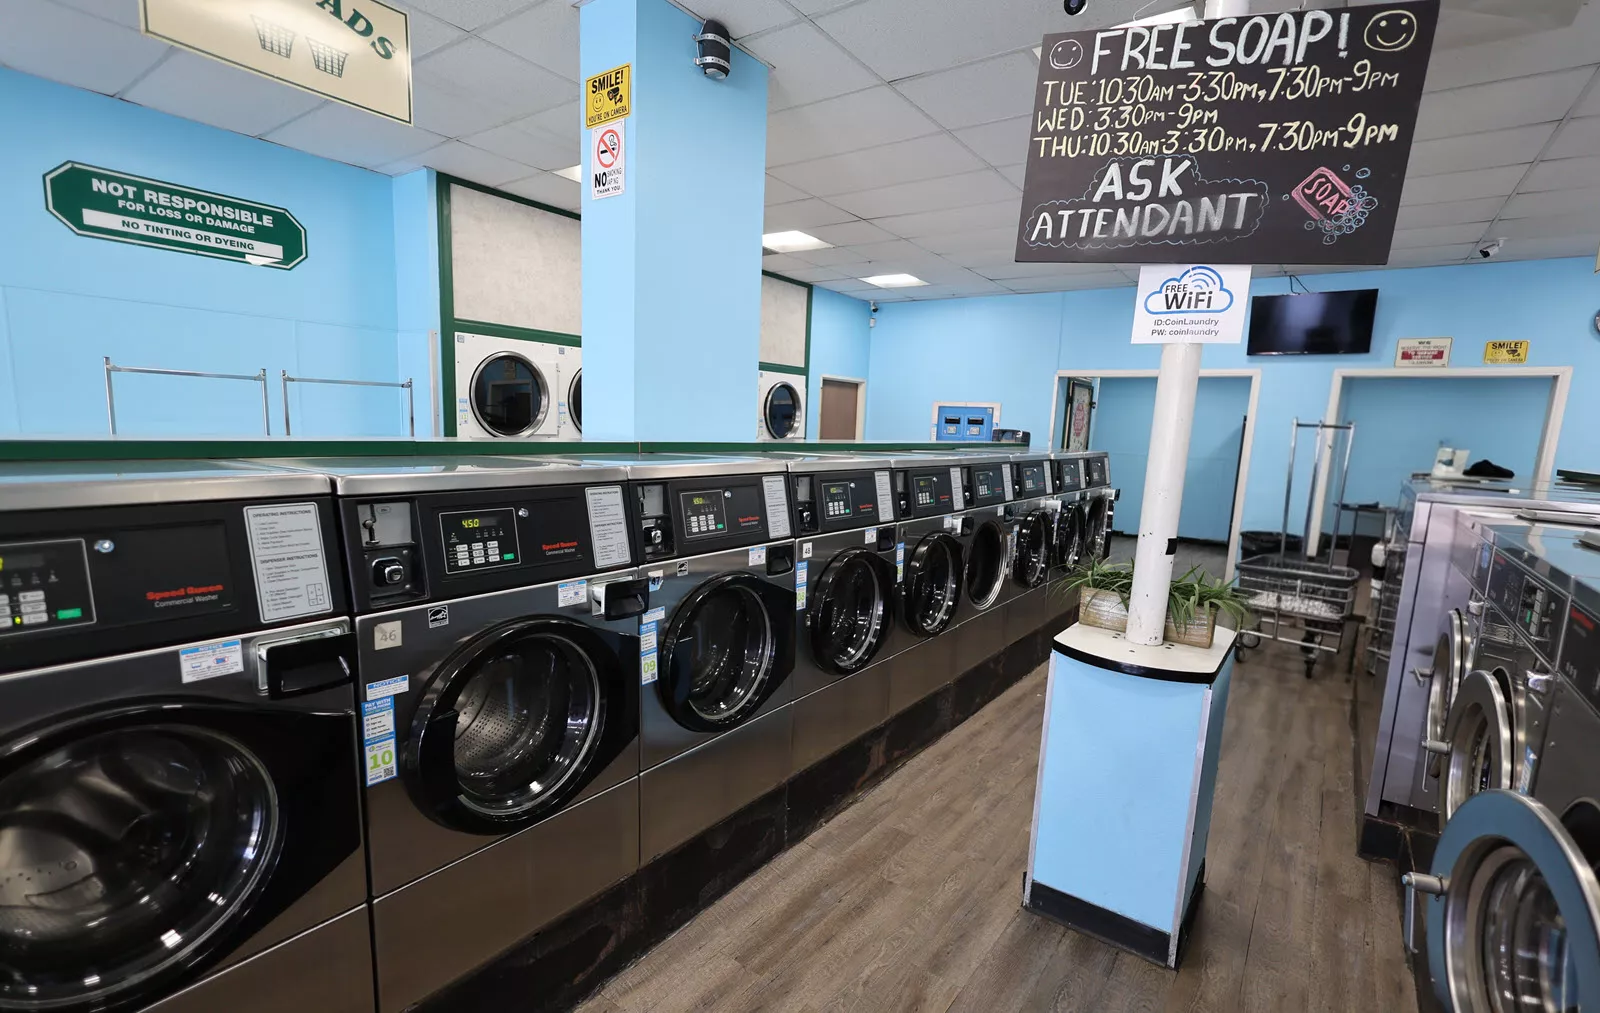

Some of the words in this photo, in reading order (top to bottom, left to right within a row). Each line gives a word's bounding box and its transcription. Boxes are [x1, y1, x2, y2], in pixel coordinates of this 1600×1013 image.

[1091, 20, 1205, 75] FREE
[592, 70, 623, 94] SMILE!
[611, 105, 627, 117] CAMERA
[595, 172, 607, 188] NO
[1092, 158, 1192, 202] ASK
[91, 178, 137, 199] NOT
[143, 189, 274, 227] RESPONSIBLE
[1304, 178, 1349, 215] SOAP
[118, 200, 145, 213] FOR
[149, 205, 181, 220] LOSS
[185, 213, 203, 224] OR
[206, 217, 255, 234] DAMAGE
[1031, 192, 1259, 241] ATTENDANT
[122, 220, 140, 230] NO
[144, 223, 192, 240] TINTING
[195, 233, 212, 243] OR
[214, 237, 255, 251] DYEING
[1165, 283, 1188, 293] FREE
[1165, 291, 1213, 310] WiFi
[1169, 328, 1219, 336] coinlaundry
[651, 576, 660, 586] 47
[146, 587, 186, 600] Speed
[154, 597, 194, 607] Commercial
[194, 594, 218, 603] Washer
[380, 629, 397, 642] 46
[643, 660, 656, 674] 09
[369, 749, 393, 771] 10
